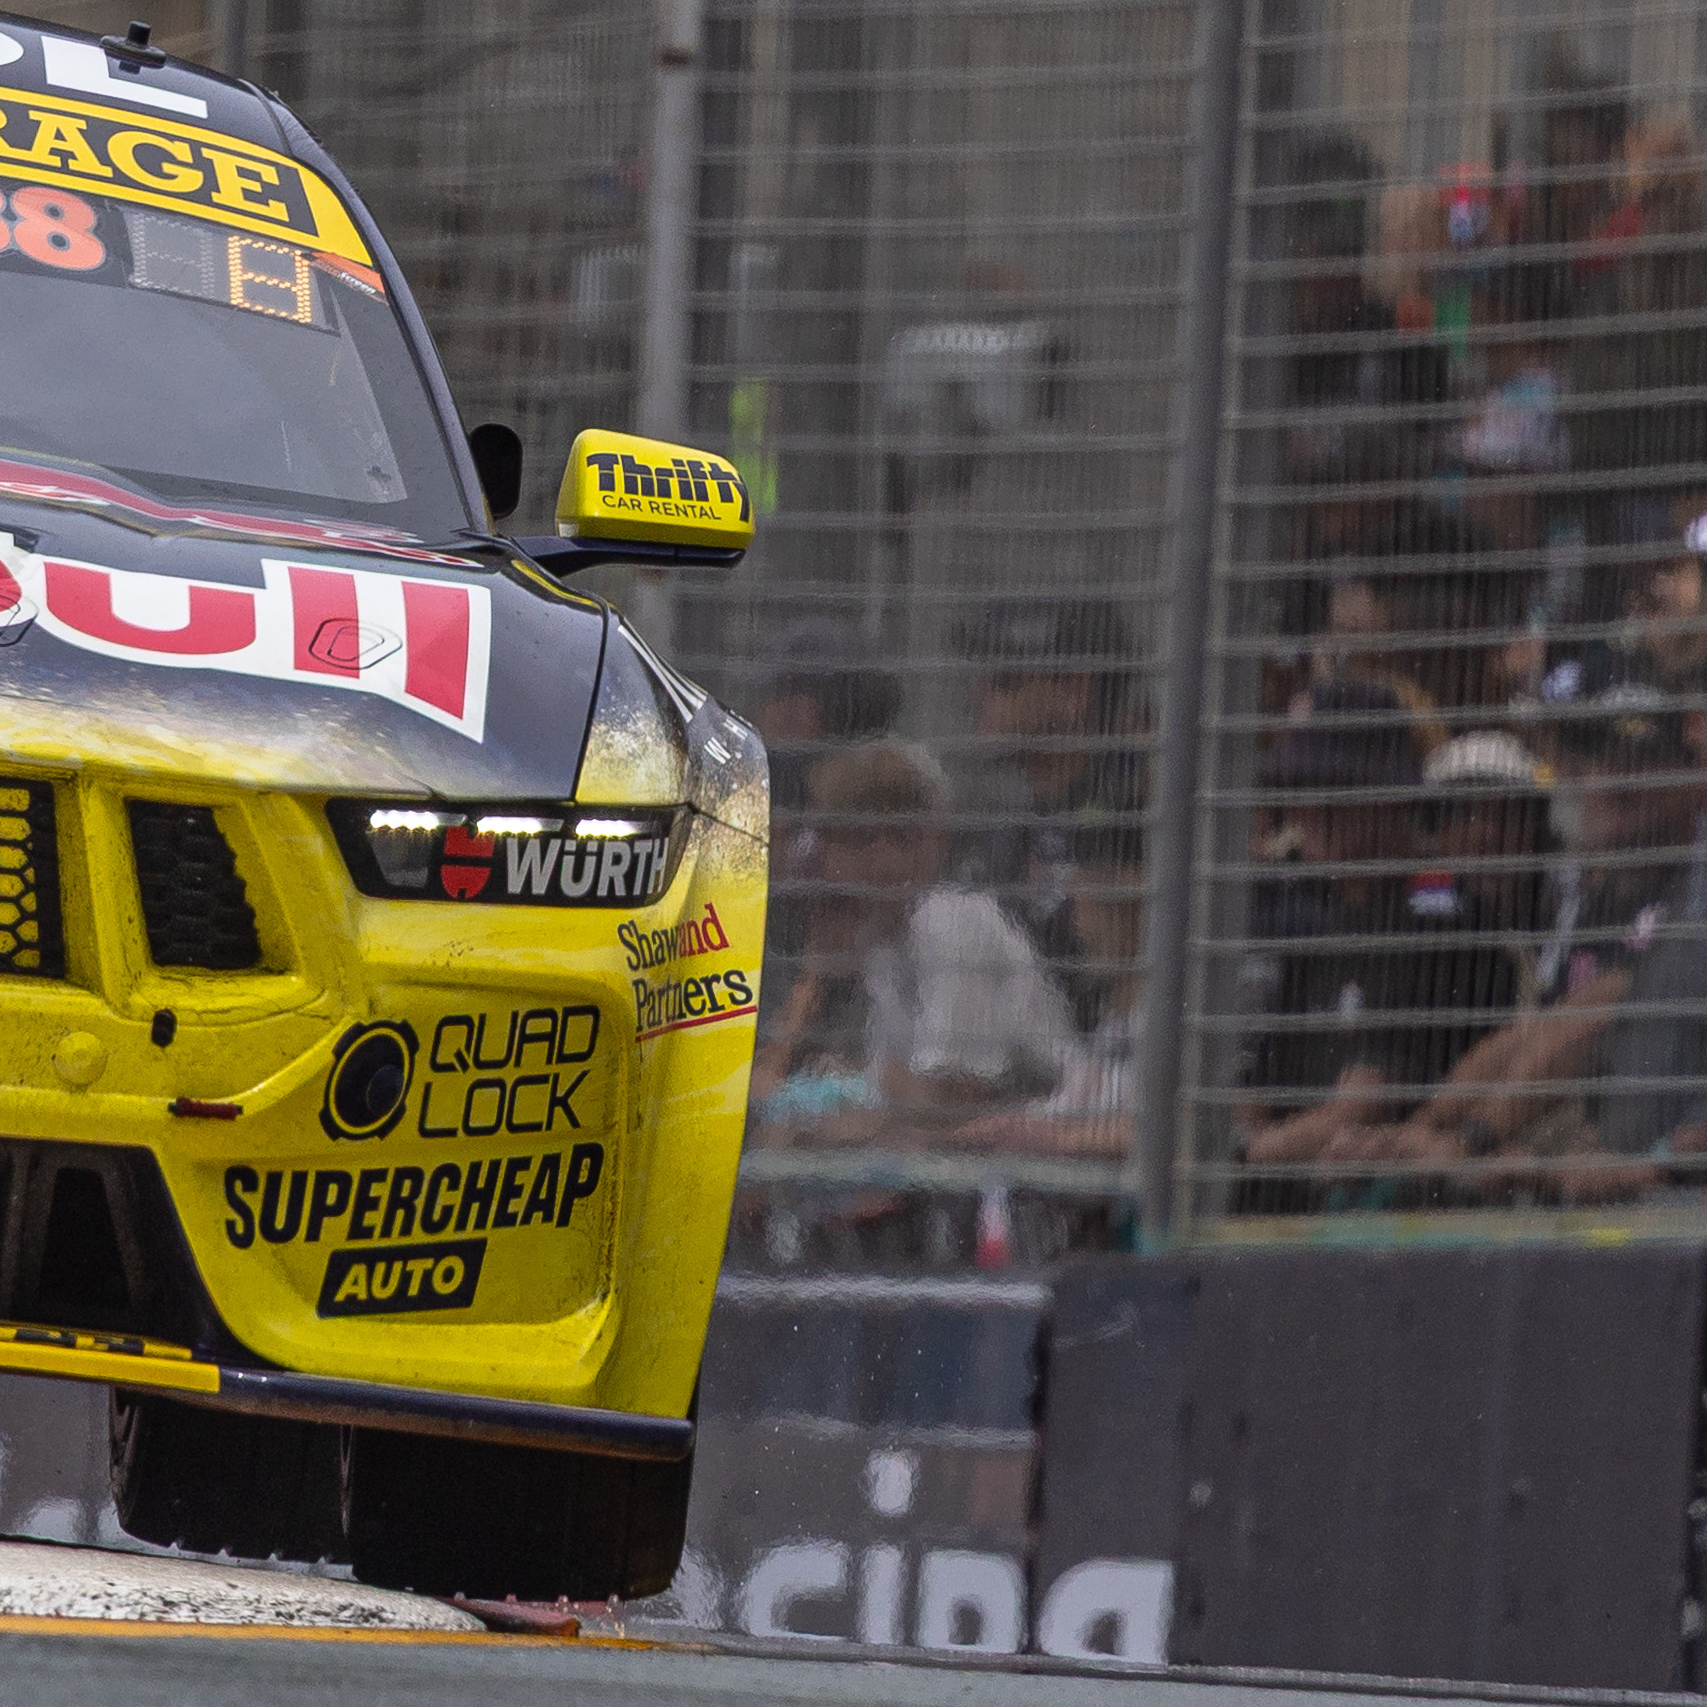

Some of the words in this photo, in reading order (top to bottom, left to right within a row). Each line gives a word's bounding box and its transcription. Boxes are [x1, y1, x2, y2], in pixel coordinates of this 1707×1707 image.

[586, 452, 750, 524] Thrifty
[602, 495, 643, 512] CAR
[650, 502, 723, 521] RENTAL
[632, 969, 754, 1035] Partners
[429, 1005, 601, 1075] QUAD
[418, 1070, 593, 1140] LOCK
[222, 1141, 605, 1251] SUPERCHEAP
[334, 1254, 466, 1304] AUTO
